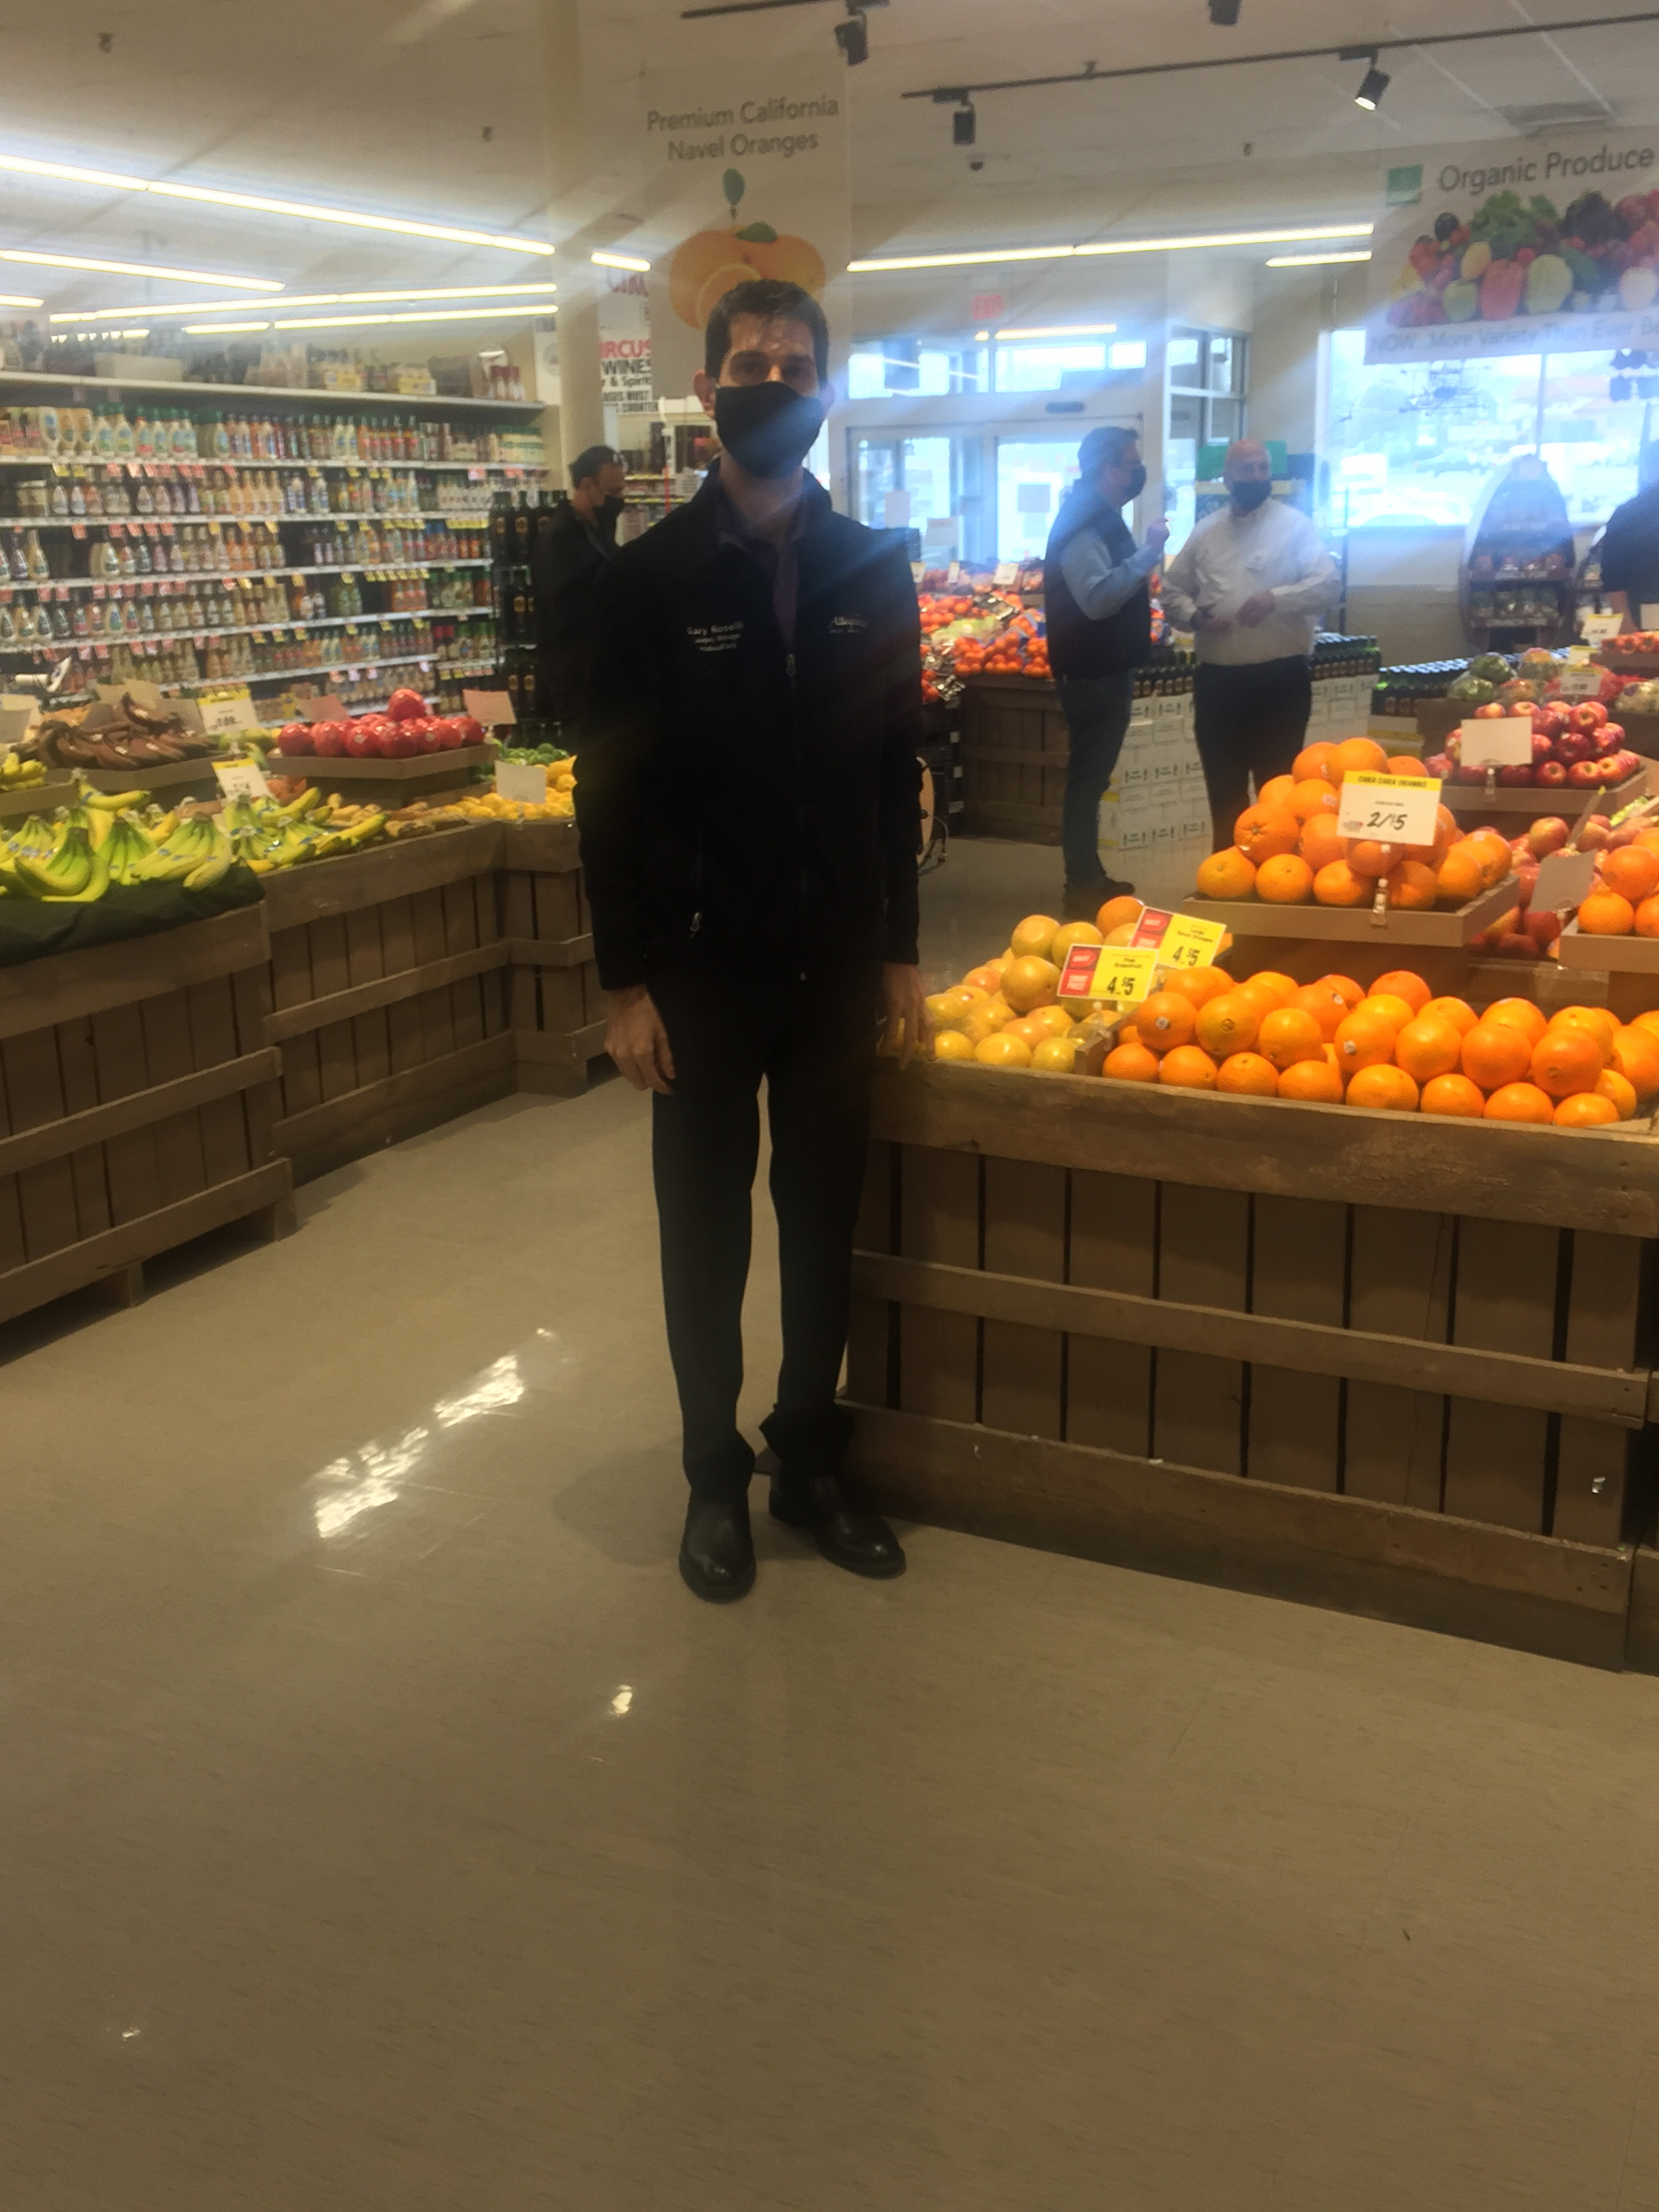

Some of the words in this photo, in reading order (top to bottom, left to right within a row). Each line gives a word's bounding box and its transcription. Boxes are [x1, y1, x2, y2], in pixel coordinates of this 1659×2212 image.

[647, 107, 734, 131] Premium
[740, 96, 840, 125] California
[668, 137, 725, 162] Navel
[729, 131, 819, 157] Oranges
[1439, 157, 1538, 195] Organic
[1546, 145, 1654, 179] Produce
